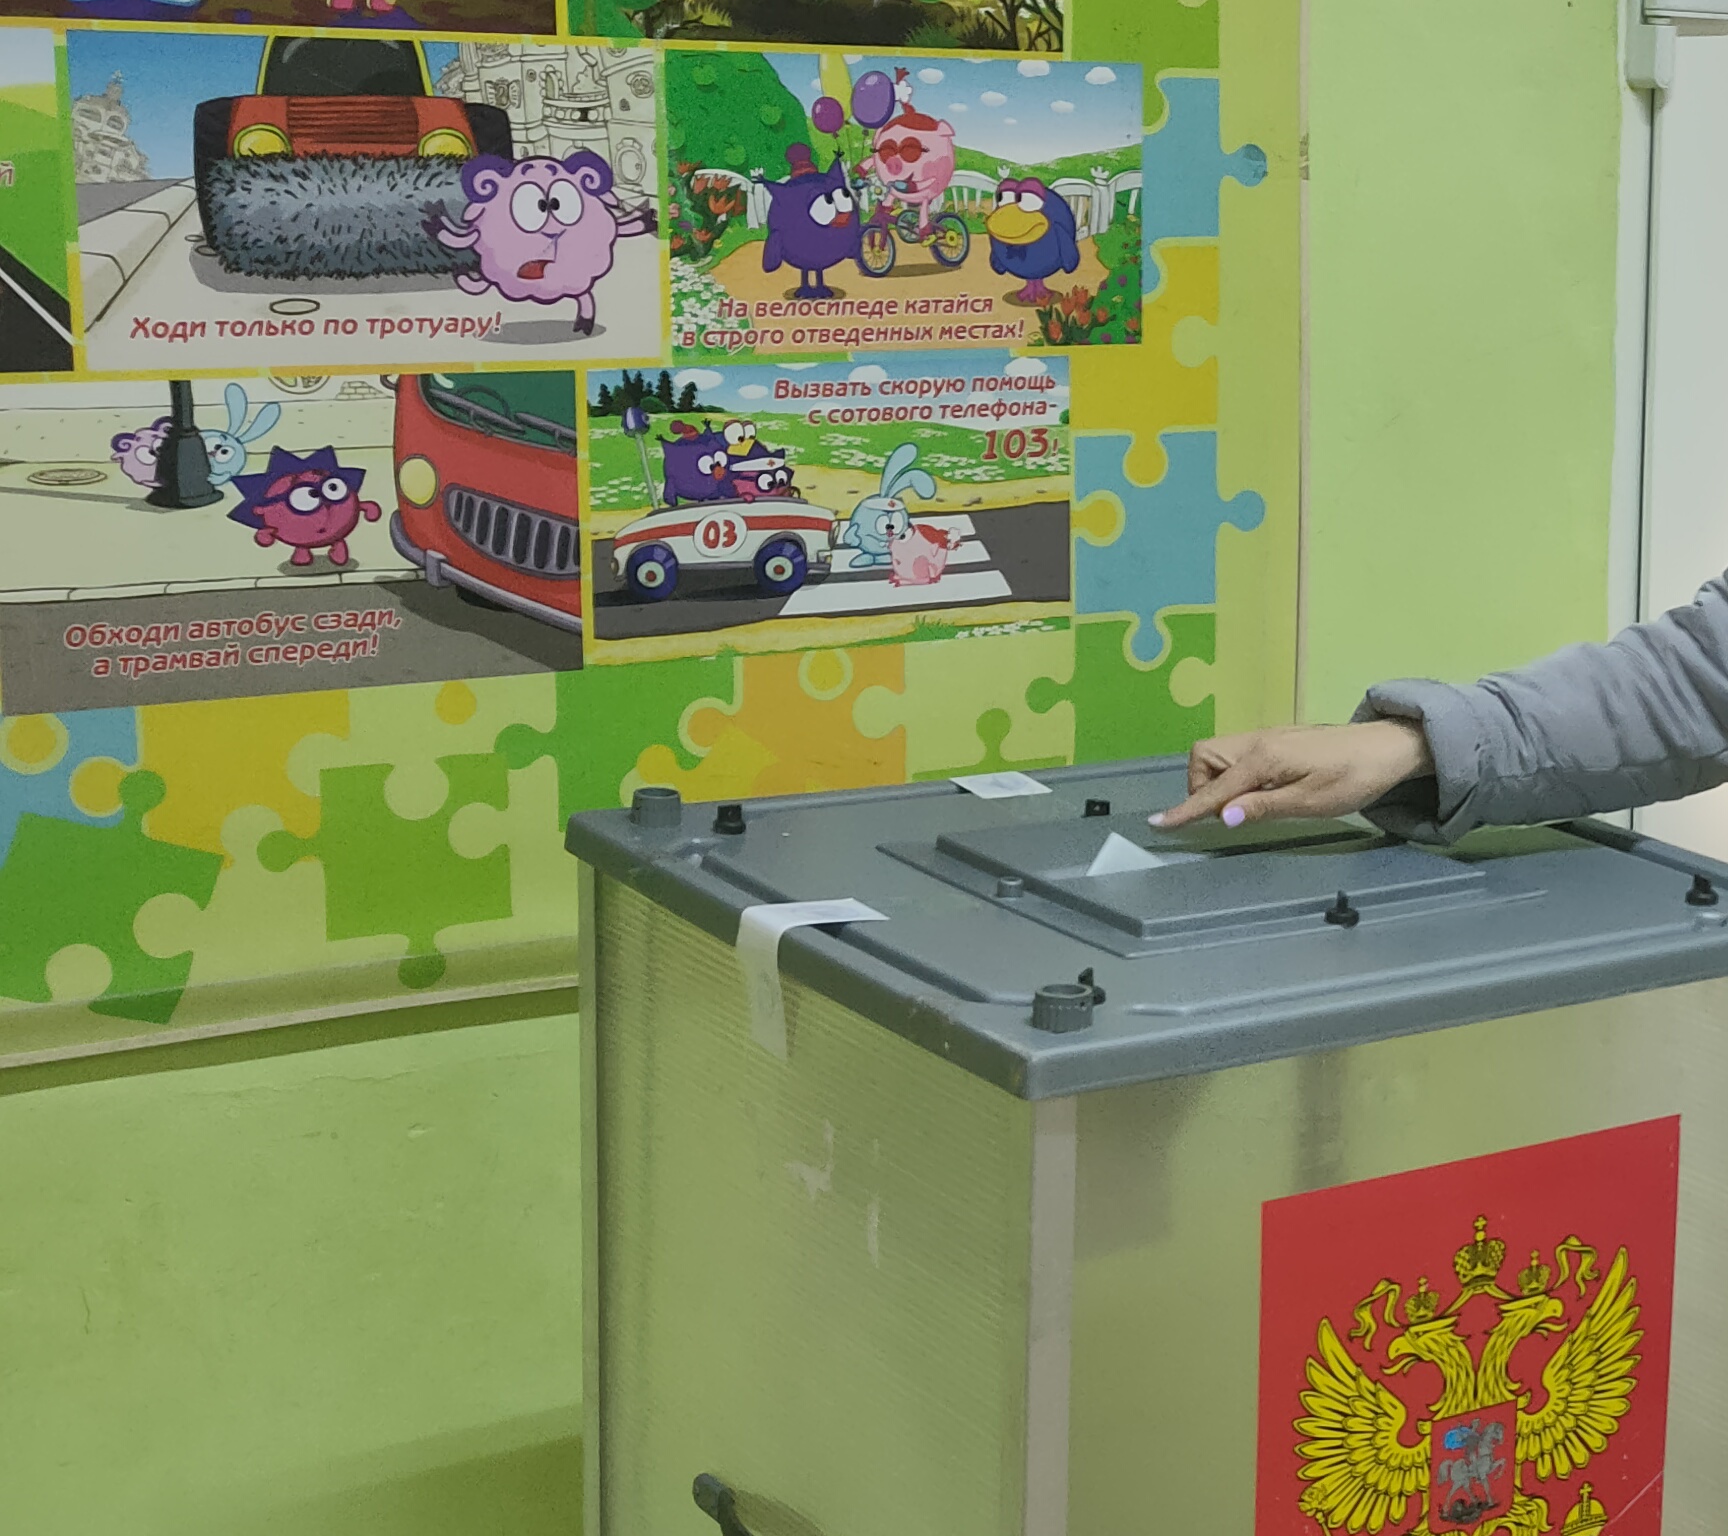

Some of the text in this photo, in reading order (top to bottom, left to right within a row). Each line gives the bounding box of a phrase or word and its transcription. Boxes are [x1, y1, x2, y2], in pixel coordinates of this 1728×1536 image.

[717, 293, 993, 319] На велосипеде катайся
[130, 311, 502, 343] Ходи только по тротуару!
[682, 319, 1025, 350] в строго отведенных местах!
[774, 375, 1056, 401] Вызвать скорую помощь
[808, 408, 822, 426] с
[827, 404, 933, 425] сотового
[981, 428, 1059, 460] 103!
[703, 519, 737, 549] 03
[65, 608, 402, 649] Обходи автобус сзади,
[92, 634, 379, 678] а трамвай спереди!
